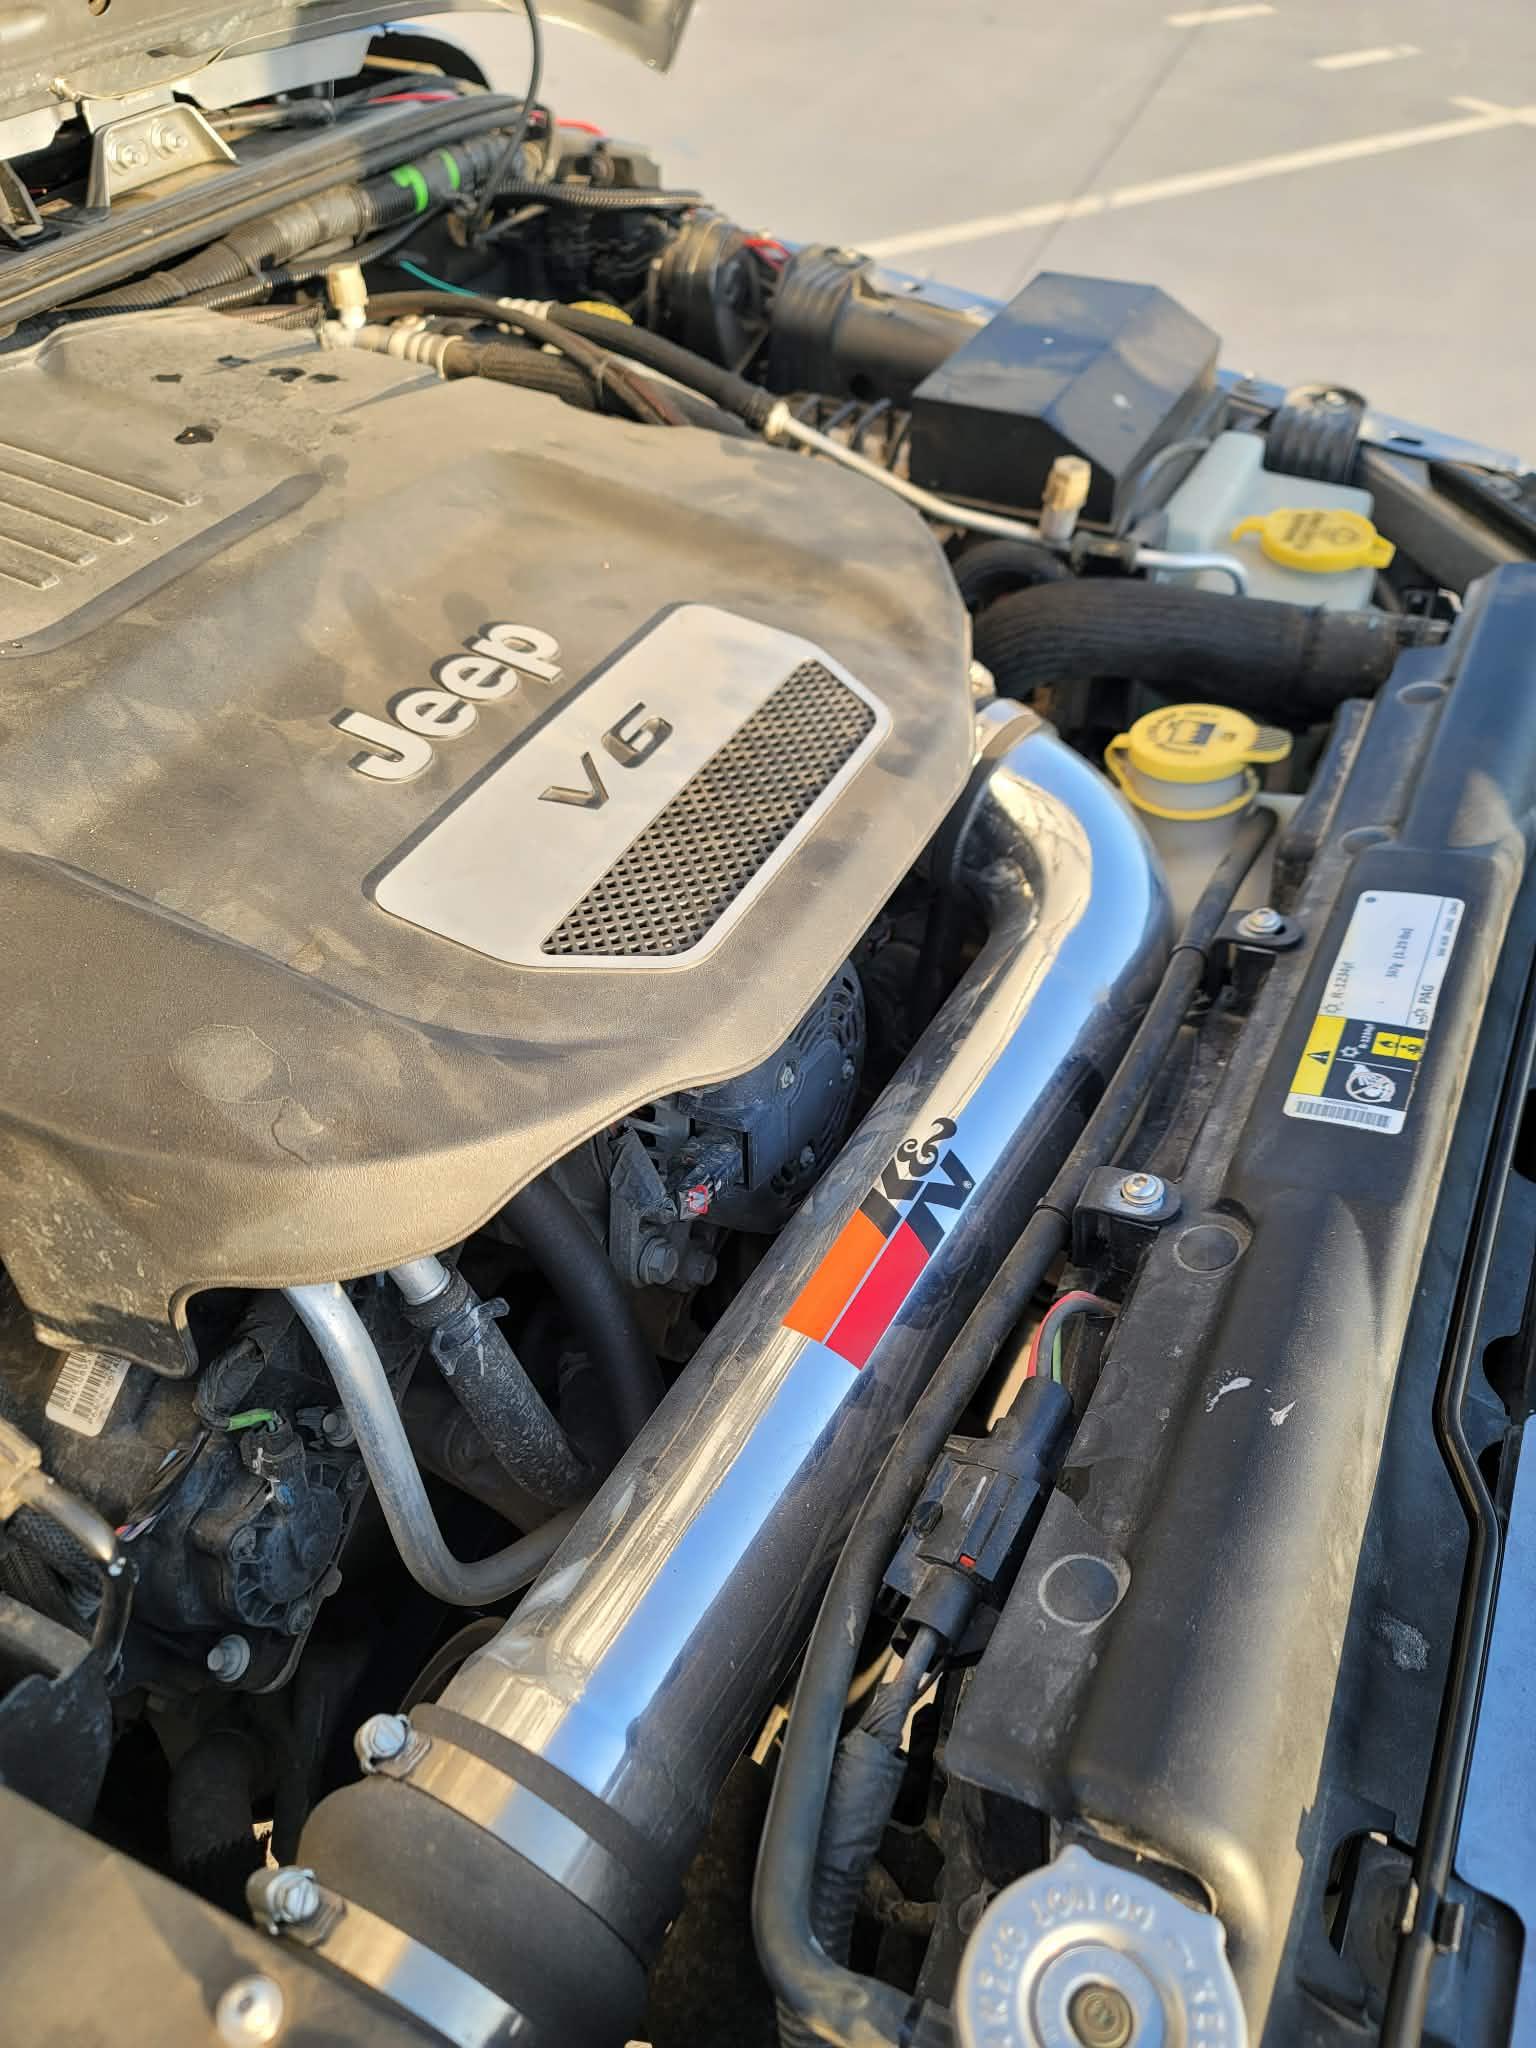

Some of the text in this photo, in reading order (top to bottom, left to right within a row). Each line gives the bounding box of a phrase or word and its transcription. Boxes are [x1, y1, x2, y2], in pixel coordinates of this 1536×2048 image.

[330, 622, 563, 782] Jeep
[537, 702, 673, 810] V6
[1417, 985, 1434, 1005] PAG
